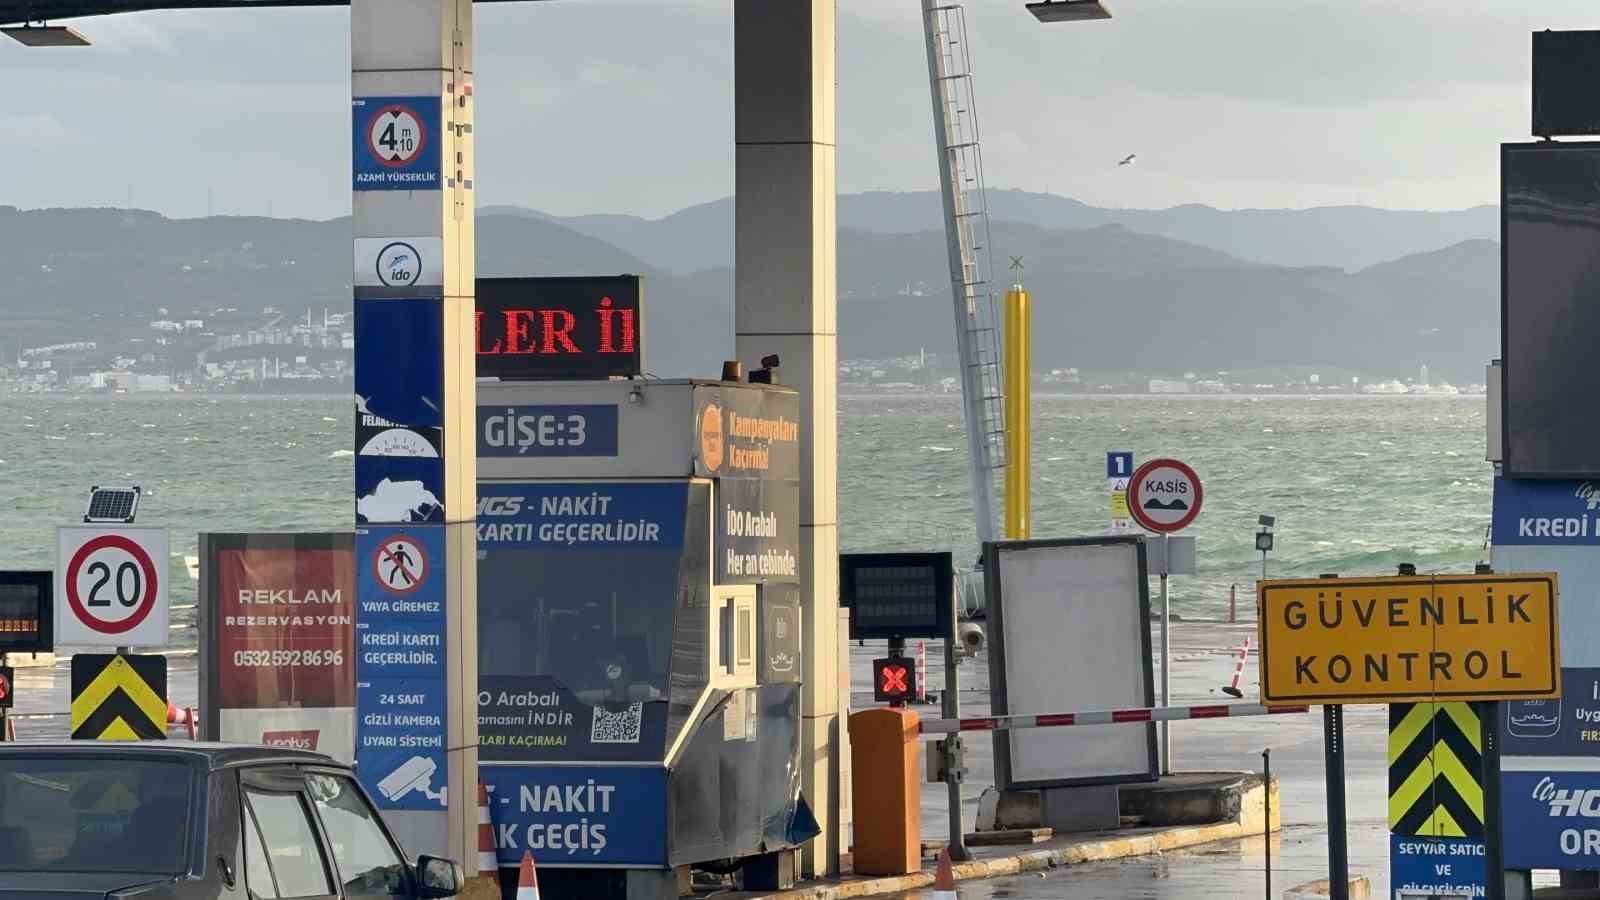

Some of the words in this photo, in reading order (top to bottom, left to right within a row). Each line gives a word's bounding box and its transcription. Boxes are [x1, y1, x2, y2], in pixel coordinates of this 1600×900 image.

[379, 121, 398, 151] 4
[401, 127, 411, 137] m
[356, 171, 385, 182] AZAMİ
[386, 171, 436, 182] YÜKSEKLİK
[391, 269, 411, 281] ido
[475, 310, 582, 354] LER
[484, 408, 586, 454] GİŞE:3
[729, 411, 799, 445] Kampanyaları
[1115, 456, 1125, 474] 1
[1145, 478, 1188, 494] KASİS
[541, 492, 613, 516] NAKİT
[727, 503, 743, 537] İDO
[744, 510, 777, 537] Arabalı
[1519, 513, 1588, 537] KREDİ
[539, 519, 660, 545] GEÇERLİDİR
[727, 548, 744, 575] Her
[745, 555, 757, 575] an
[759, 548, 796, 576] cebinde
[87, 561, 141, 607] 20
[239, 589, 342, 604] REKLAM
[362, 601, 390, 612] YAYA
[392, 600, 440, 612] GİREMEZ
[1283, 587, 1531, 630] GÜVENLİK
[225, 615, 351, 626] REZERVASYON
[362, 632, 399, 645] KREDİ
[403, 634, 440, 646] KARTI
[364, 650, 438, 666] GEÇERLİDİR.
[1295, 650, 1522, 684] KONTROL
[379, 694, 394, 705] 24
[397, 694, 425, 705] SAAT
[496, 691, 560, 707] Arabalı
[364, 712, 391, 726] GİZLİ
[394, 715, 441, 726] KAMERA
[528, 710, 574, 726] İNDİR
[363, 736, 397, 747] UYARI
[399, 734, 442, 747] SİSTEMİ
[479, 735, 506, 745] LARI
[508, 735, 568, 748] KAÇIRMA!
[1582, 730, 1600, 741] FIR
[520, 779, 616, 813] NAKİT
[527, 818, 607, 855] GEÇİŞ
[1399, 843, 1446, 855] SEYYAR
[1435, 864, 1452, 876] VE
